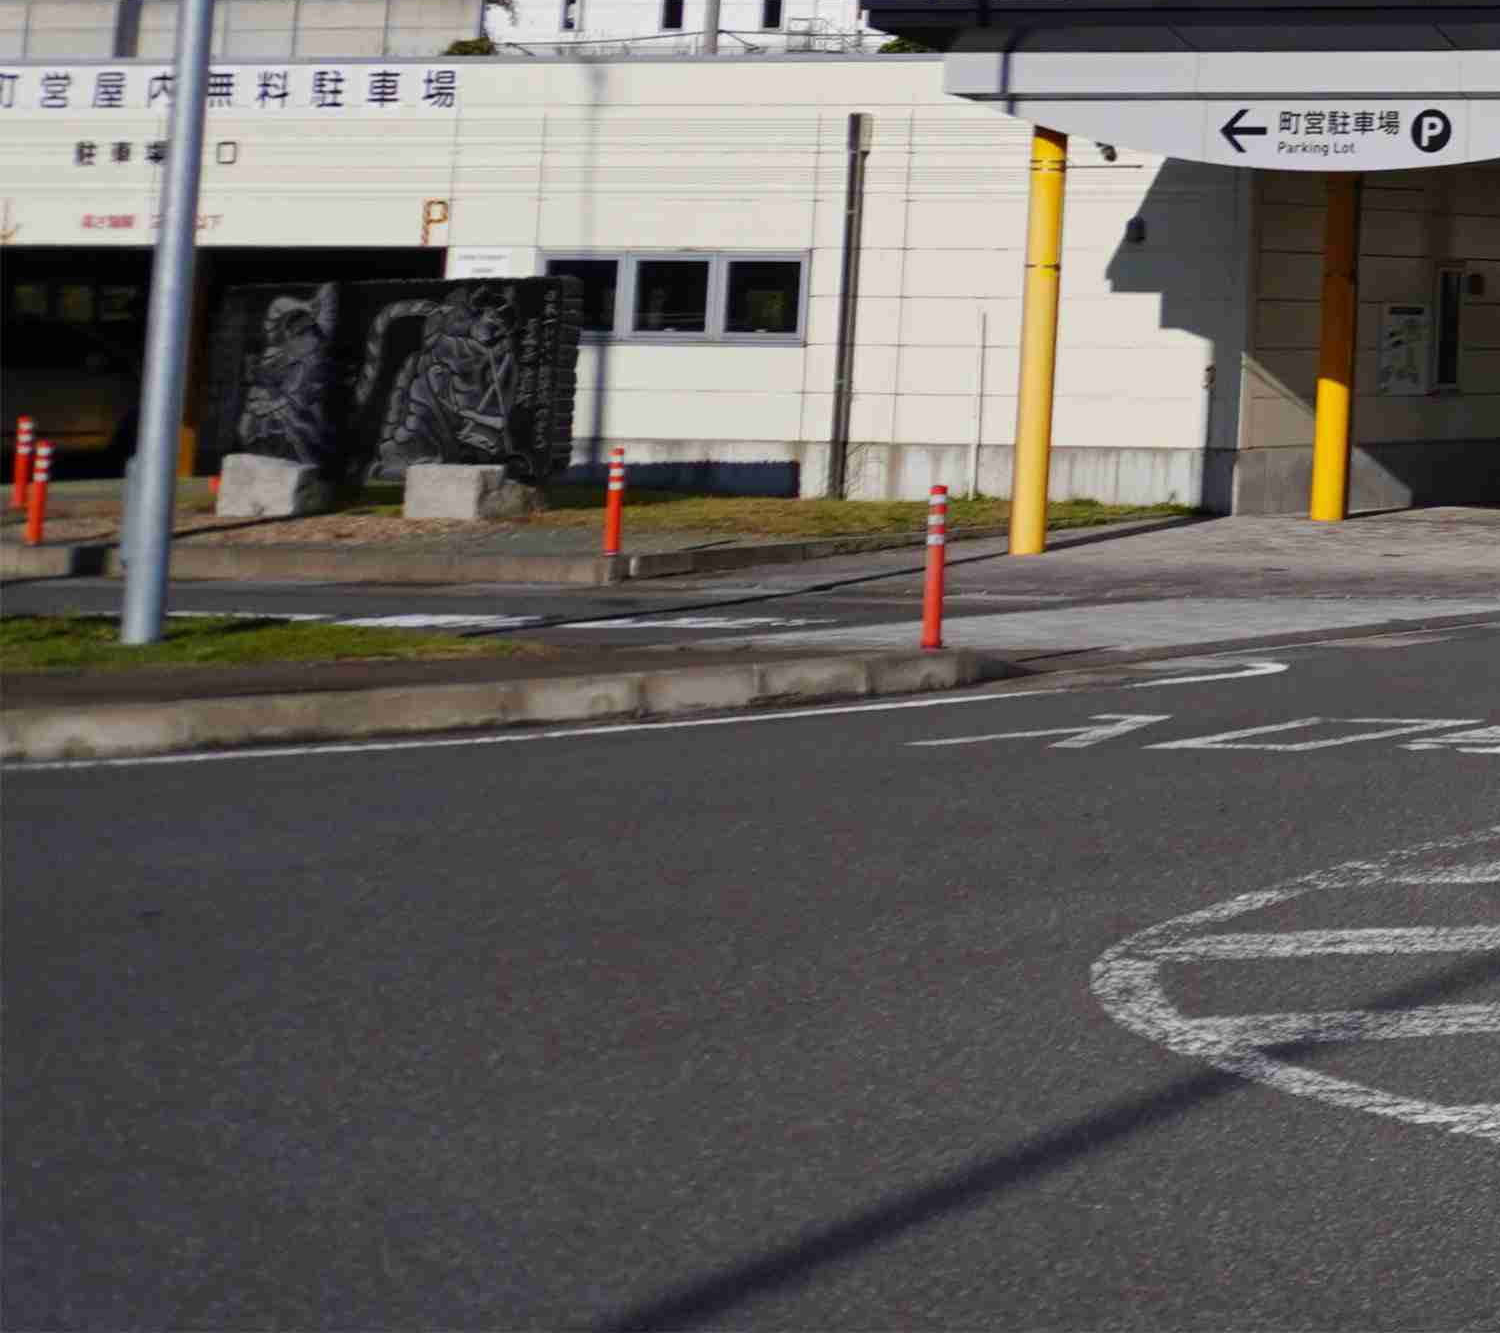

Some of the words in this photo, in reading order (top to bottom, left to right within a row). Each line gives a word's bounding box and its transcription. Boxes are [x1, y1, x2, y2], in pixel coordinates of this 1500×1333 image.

[1278, 110, 1401, 137] 町営駐車場
[1277, 141, 1329, 156] Parking
[1333, 141, 1355, 154] Lot
